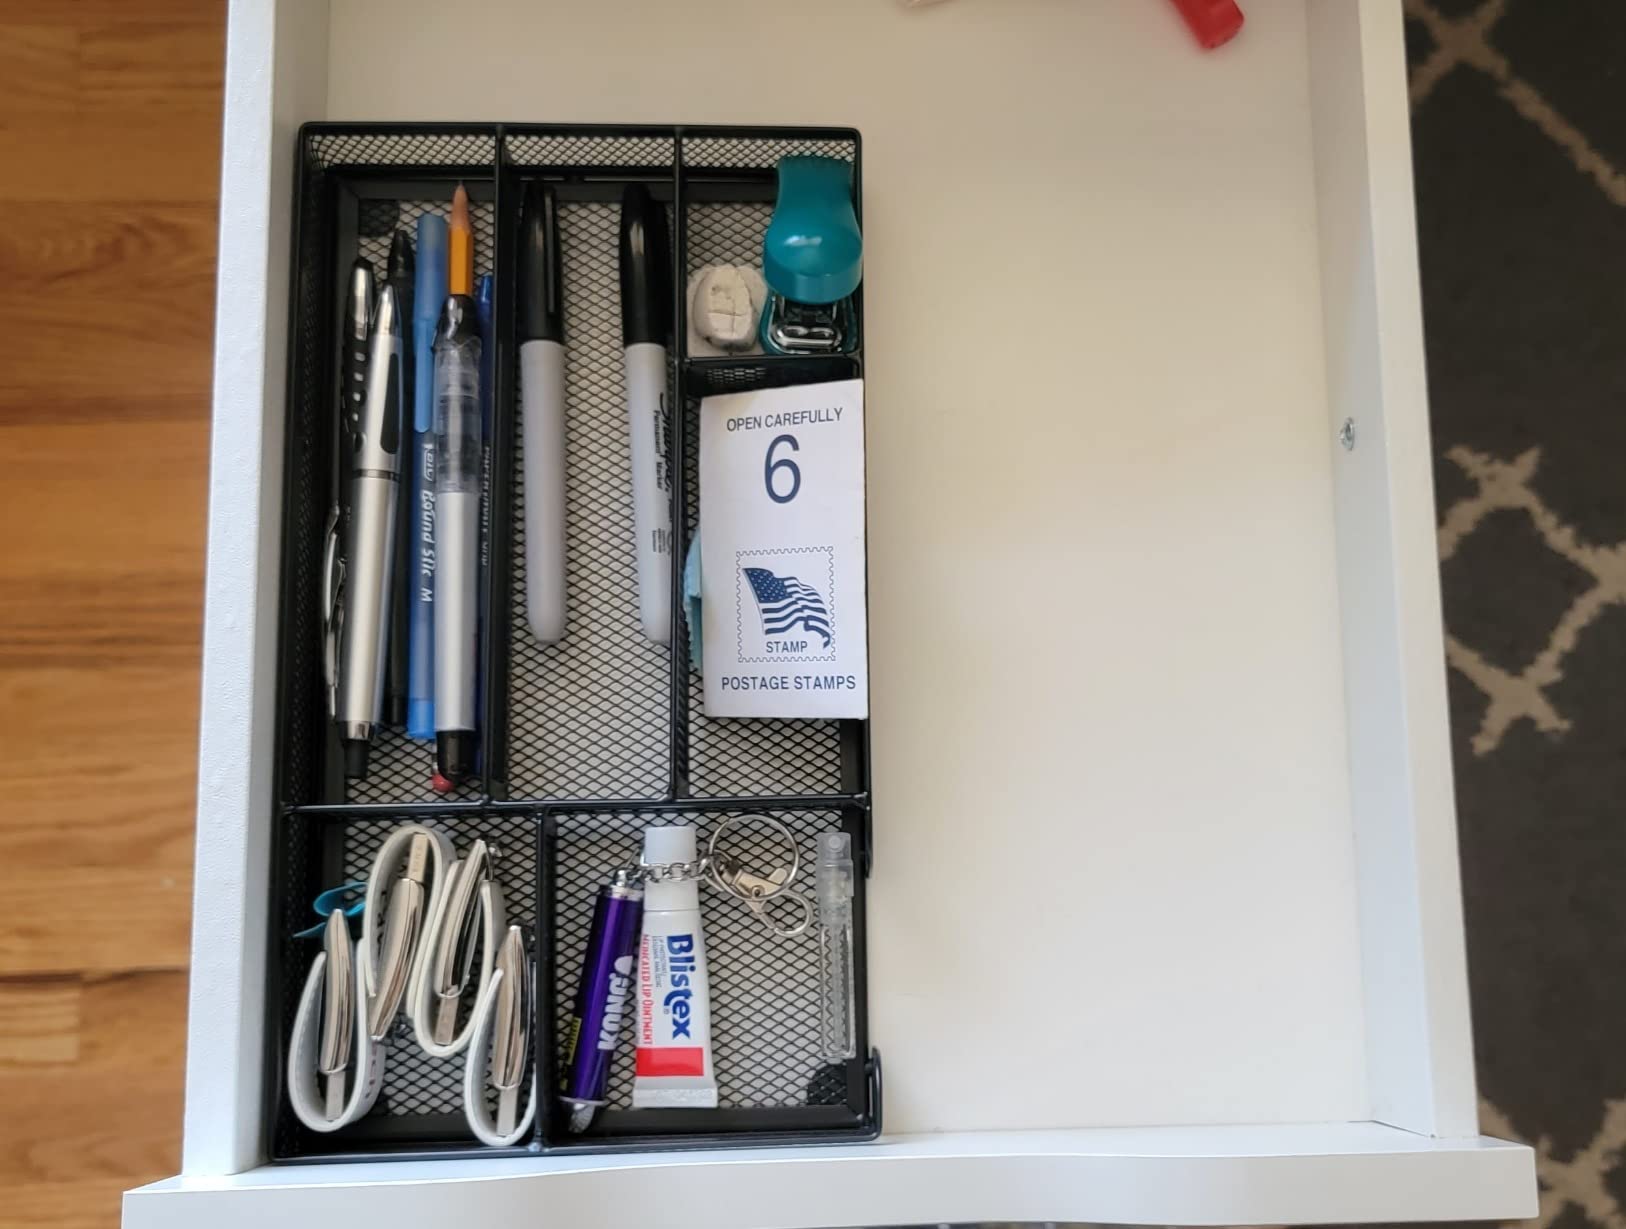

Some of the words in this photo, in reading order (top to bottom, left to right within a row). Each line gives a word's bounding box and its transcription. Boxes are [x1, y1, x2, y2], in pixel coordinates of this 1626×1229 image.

[726, 416, 762, 432] OPEN
[764, 407, 843, 428] CAREFULLY
[764, 434, 801, 504] 6
[421, 489, 435, 544] Round
[421, 545, 435, 577] Stic
[420, 588, 433, 602] M
[765, 640, 808, 653] STAMP
[721, 676, 789, 690] POSTAGE
[793, 675, 856, 690] STAMPS
[642, 983, 653, 998] LIP
[664, 934, 696, 1039] Blistex
[597, 975, 630, 1050] KONG
[642, 999, 654, 1045] OINTMENT
